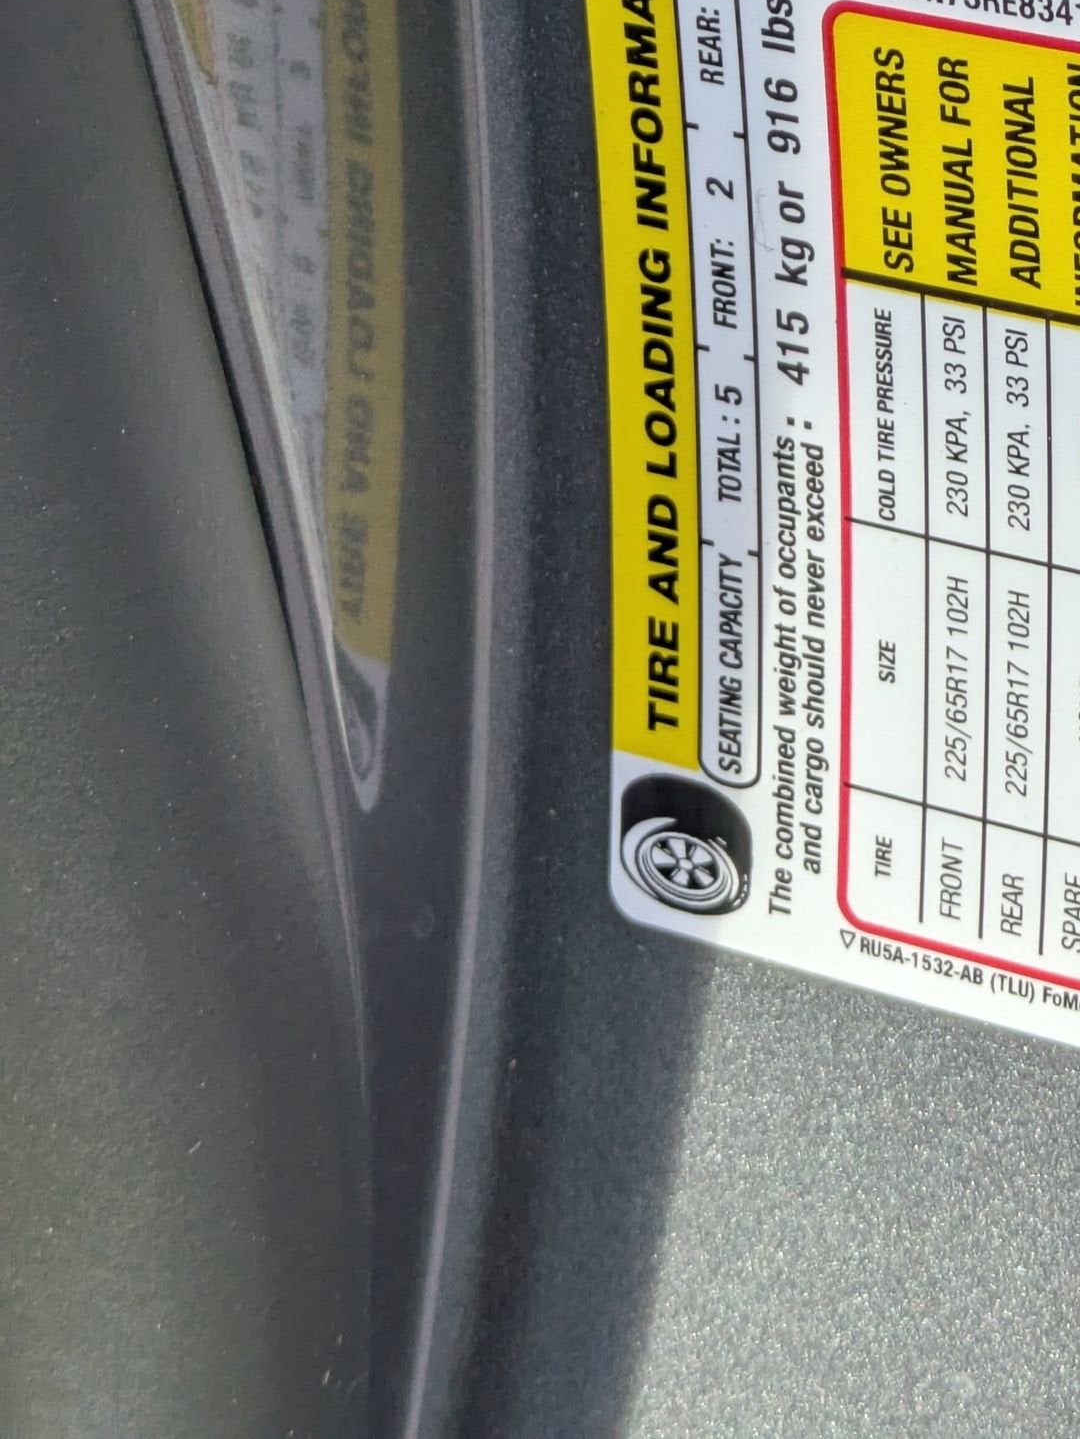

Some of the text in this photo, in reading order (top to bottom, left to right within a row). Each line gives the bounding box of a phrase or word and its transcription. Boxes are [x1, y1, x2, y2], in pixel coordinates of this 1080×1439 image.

[696, 6, 724, 86] REAR:
[763, 77, 801, 155] 916
[873, 46, 914, 273] SEE OWNERS
[937, 56, 977, 286] MANUAL FOR
[1002, 76, 1041, 289] ADDITIONAL
[705, 177, 737, 329] FRONT: 2
[774, 236, 815, 286] kg
[778, 180, 805, 224] or
[638, 248, 677, 479] LOADING
[714, 383, 742, 406] 5
[776, 308, 809, 386] 415
[874, 308, 896, 521] COLD TIRE PRESSURE
[942, 315, 970, 517] 230 KPA, 33 PSI
[1004, 328, 1030, 531] 230 33 PSI
[646, 493, 679, 606] AND
[647, 615, 679, 731] TIRE
[717, 553, 743, 775] SEATING CAPACITY
[768, 435, 802, 914] The combined weight of occupants
[799, 442, 829, 874] and cargo should never exceed
[878, 639, 895, 684] SIZE
[944, 576, 971, 781] 225/65R17 102H
[1004, 590, 1032, 797] 225/65R17 102H
[874, 835, 892, 876] TIRE
[939, 837, 962, 920] FRONT
[1000, 873, 1023, 936] REAR
[859, 936, 984, 986] RU5A-1532-AB
[989, 972, 1036, 1004] (TLU)
